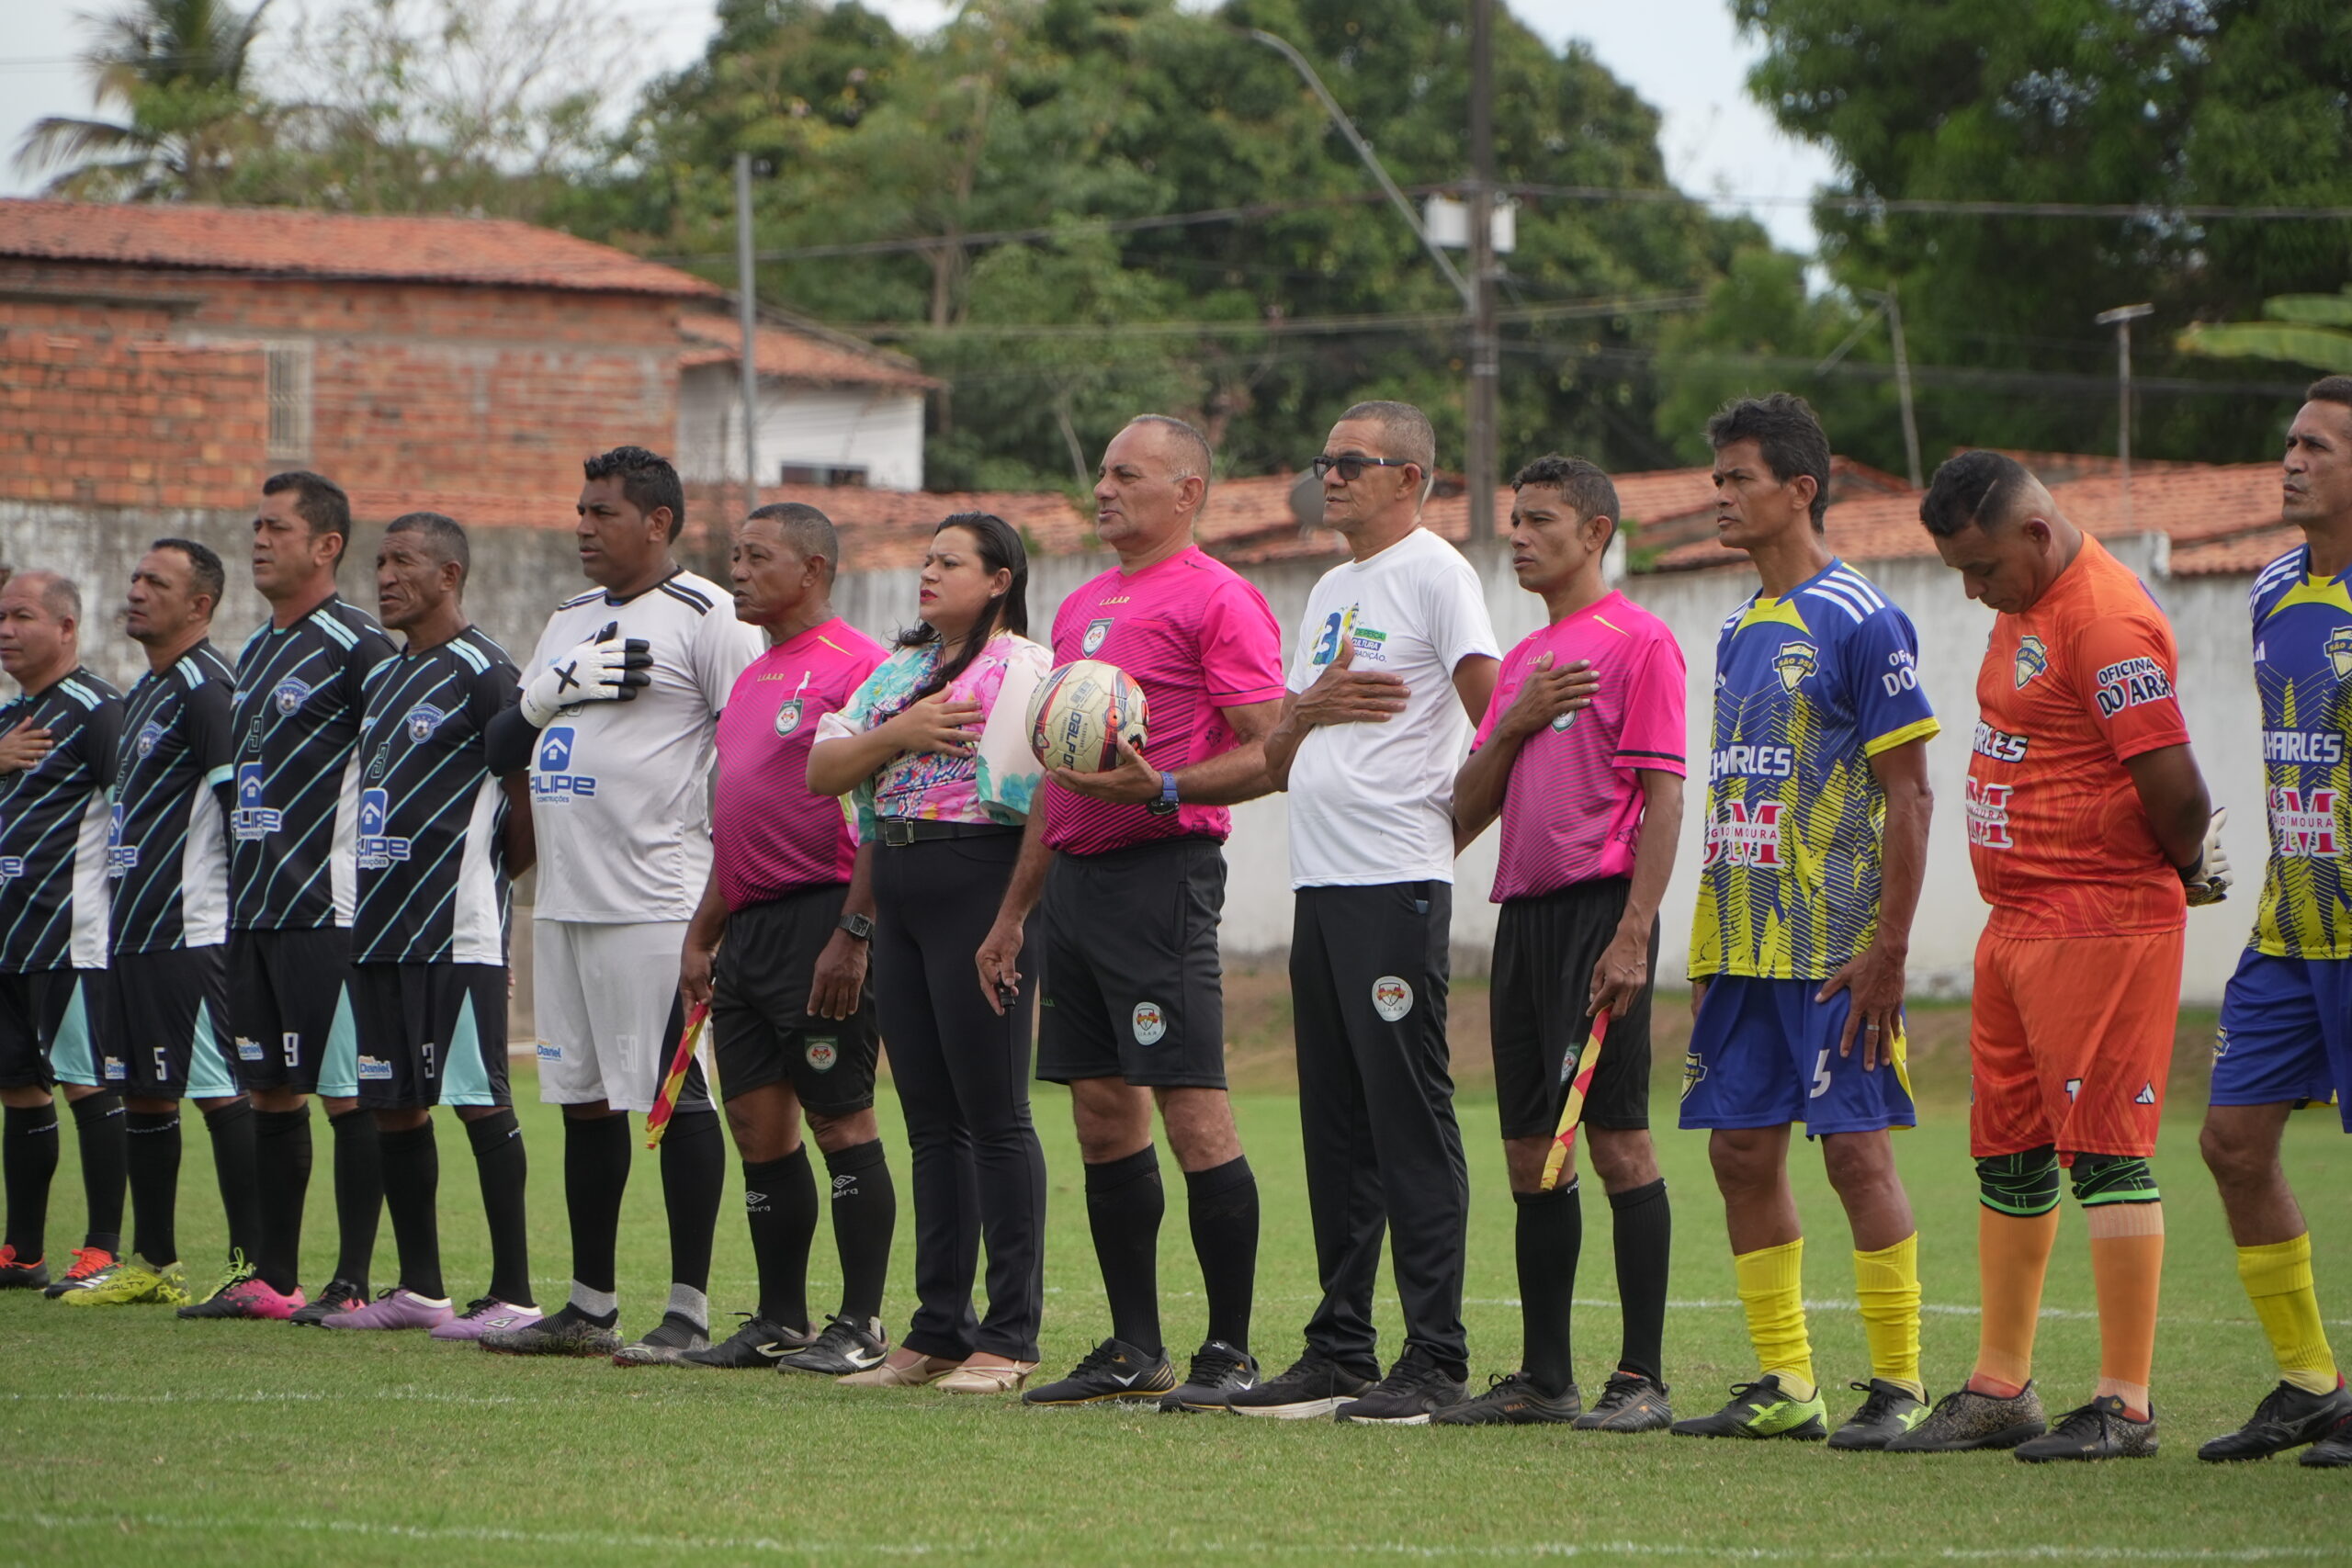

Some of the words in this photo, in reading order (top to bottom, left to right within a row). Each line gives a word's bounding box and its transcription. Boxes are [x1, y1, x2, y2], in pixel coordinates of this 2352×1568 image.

[1354, 649, 1387, 662] RADIÇÃO.
[2098, 659, 2156, 685] OFICINA
[2097, 684, 2125, 716] DO
[2291, 816, 2334, 829] MOURA
[153, 1046, 167, 1080] 5
[283, 1032, 299, 1066] 9
[422, 1043, 435, 1078] 3
[616, 1034, 639, 1073] 50
[359, 1062, 390, 1073] Daniel
